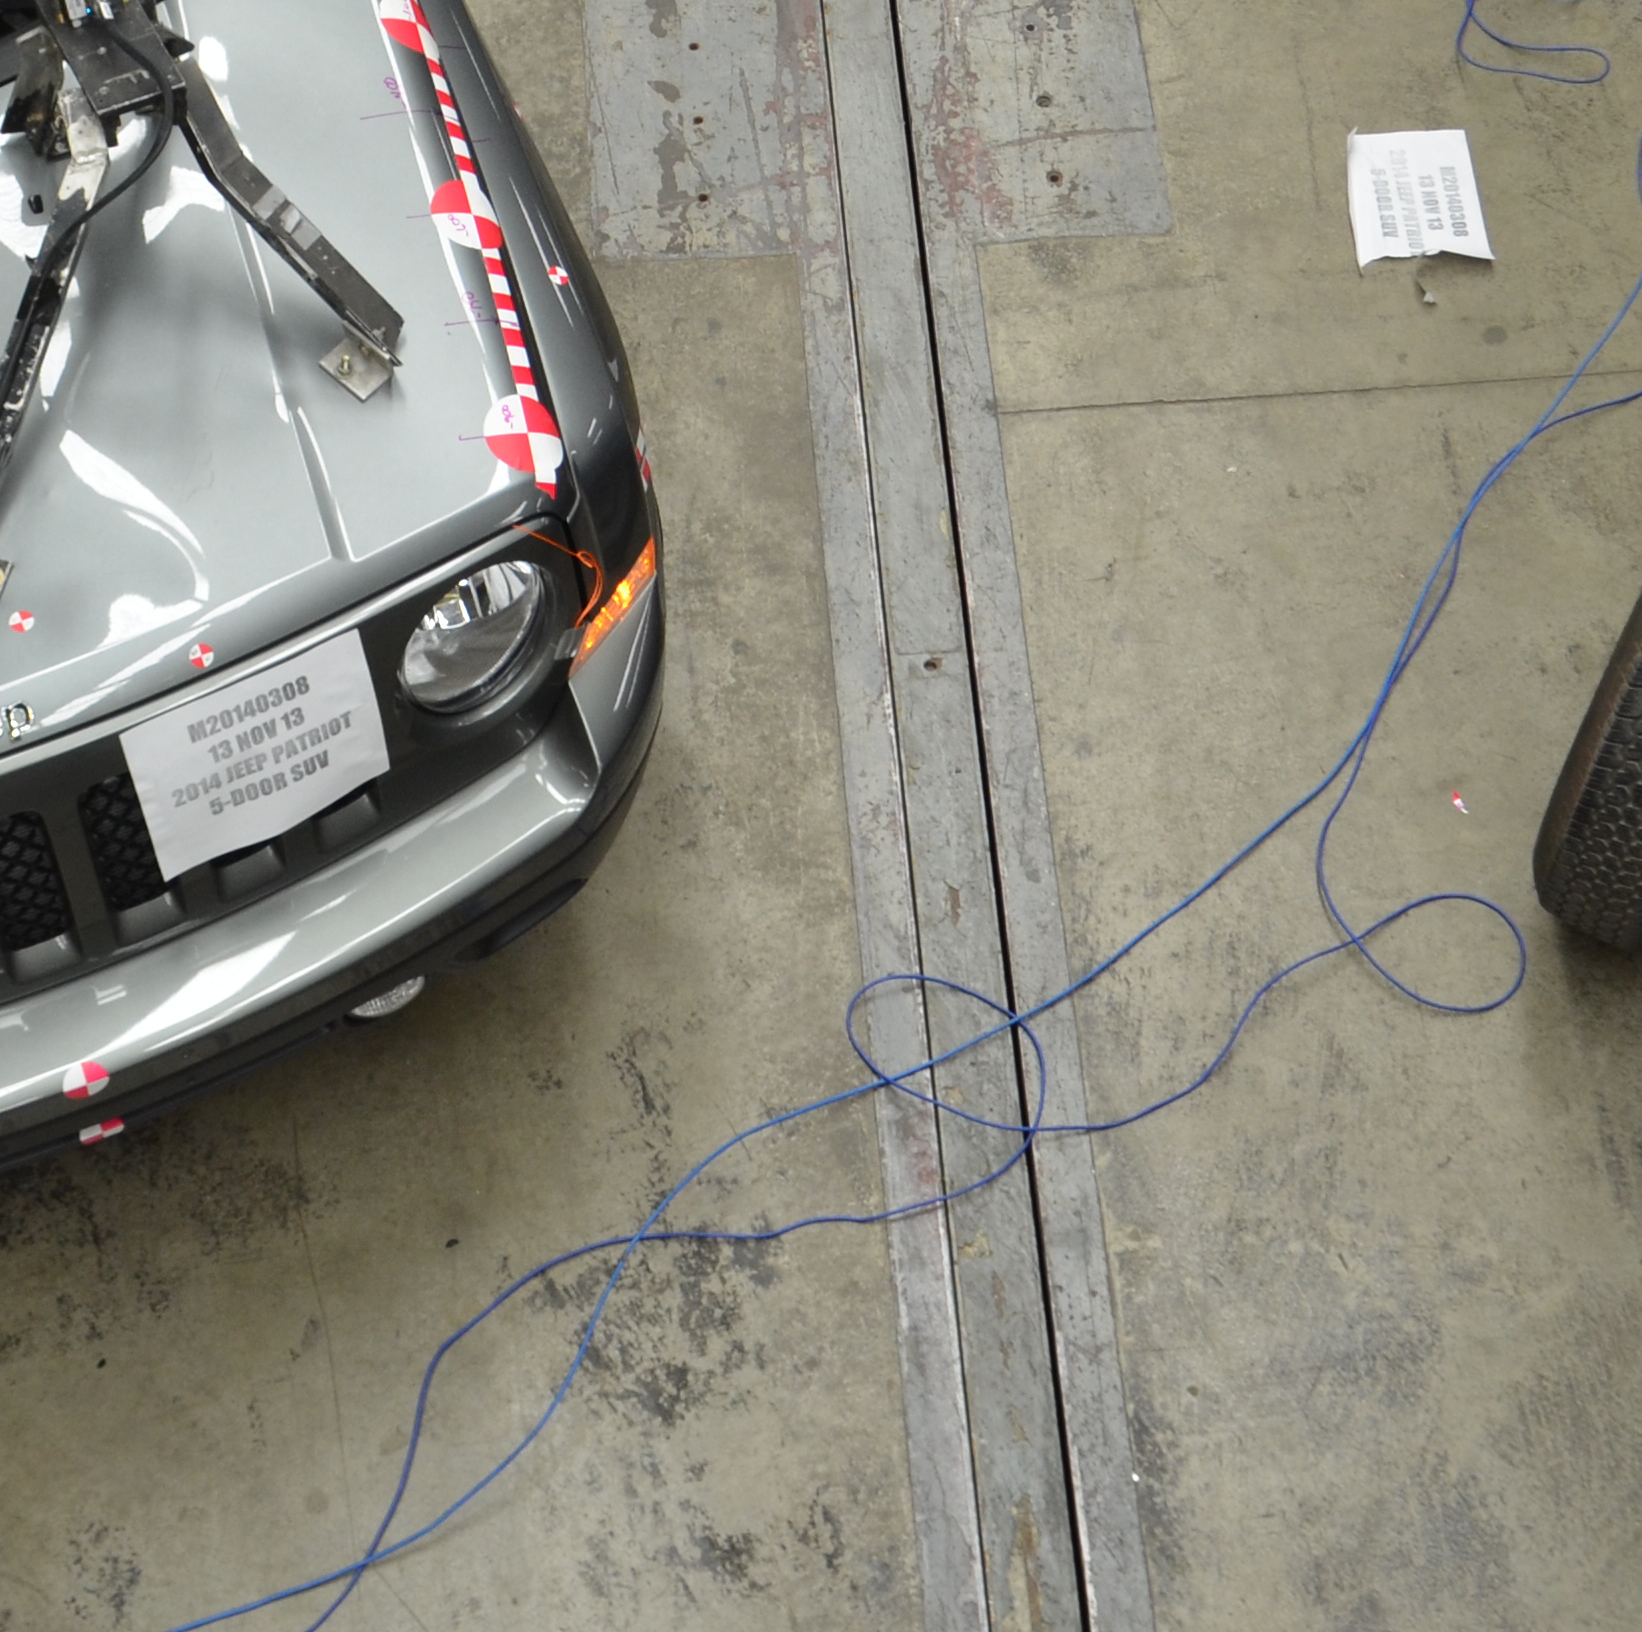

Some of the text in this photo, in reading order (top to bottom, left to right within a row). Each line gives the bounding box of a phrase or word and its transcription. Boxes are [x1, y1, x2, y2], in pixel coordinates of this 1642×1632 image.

[1370, 168, 1399, 239] 5-DOOR SUV
[1396, 181, 1415, 206] JEEP
[1418, 174, 1444, 231] 13 NOV 13
[1439, 166, 1469, 237] M20140308
[187, 674, 310, 744] M20140308
[207, 707, 305, 764] 13 NOV 13
[171, 710, 354, 808] 2014 JEEP PATRIOT
[208, 750, 330, 816] 5-DOOR SUV
